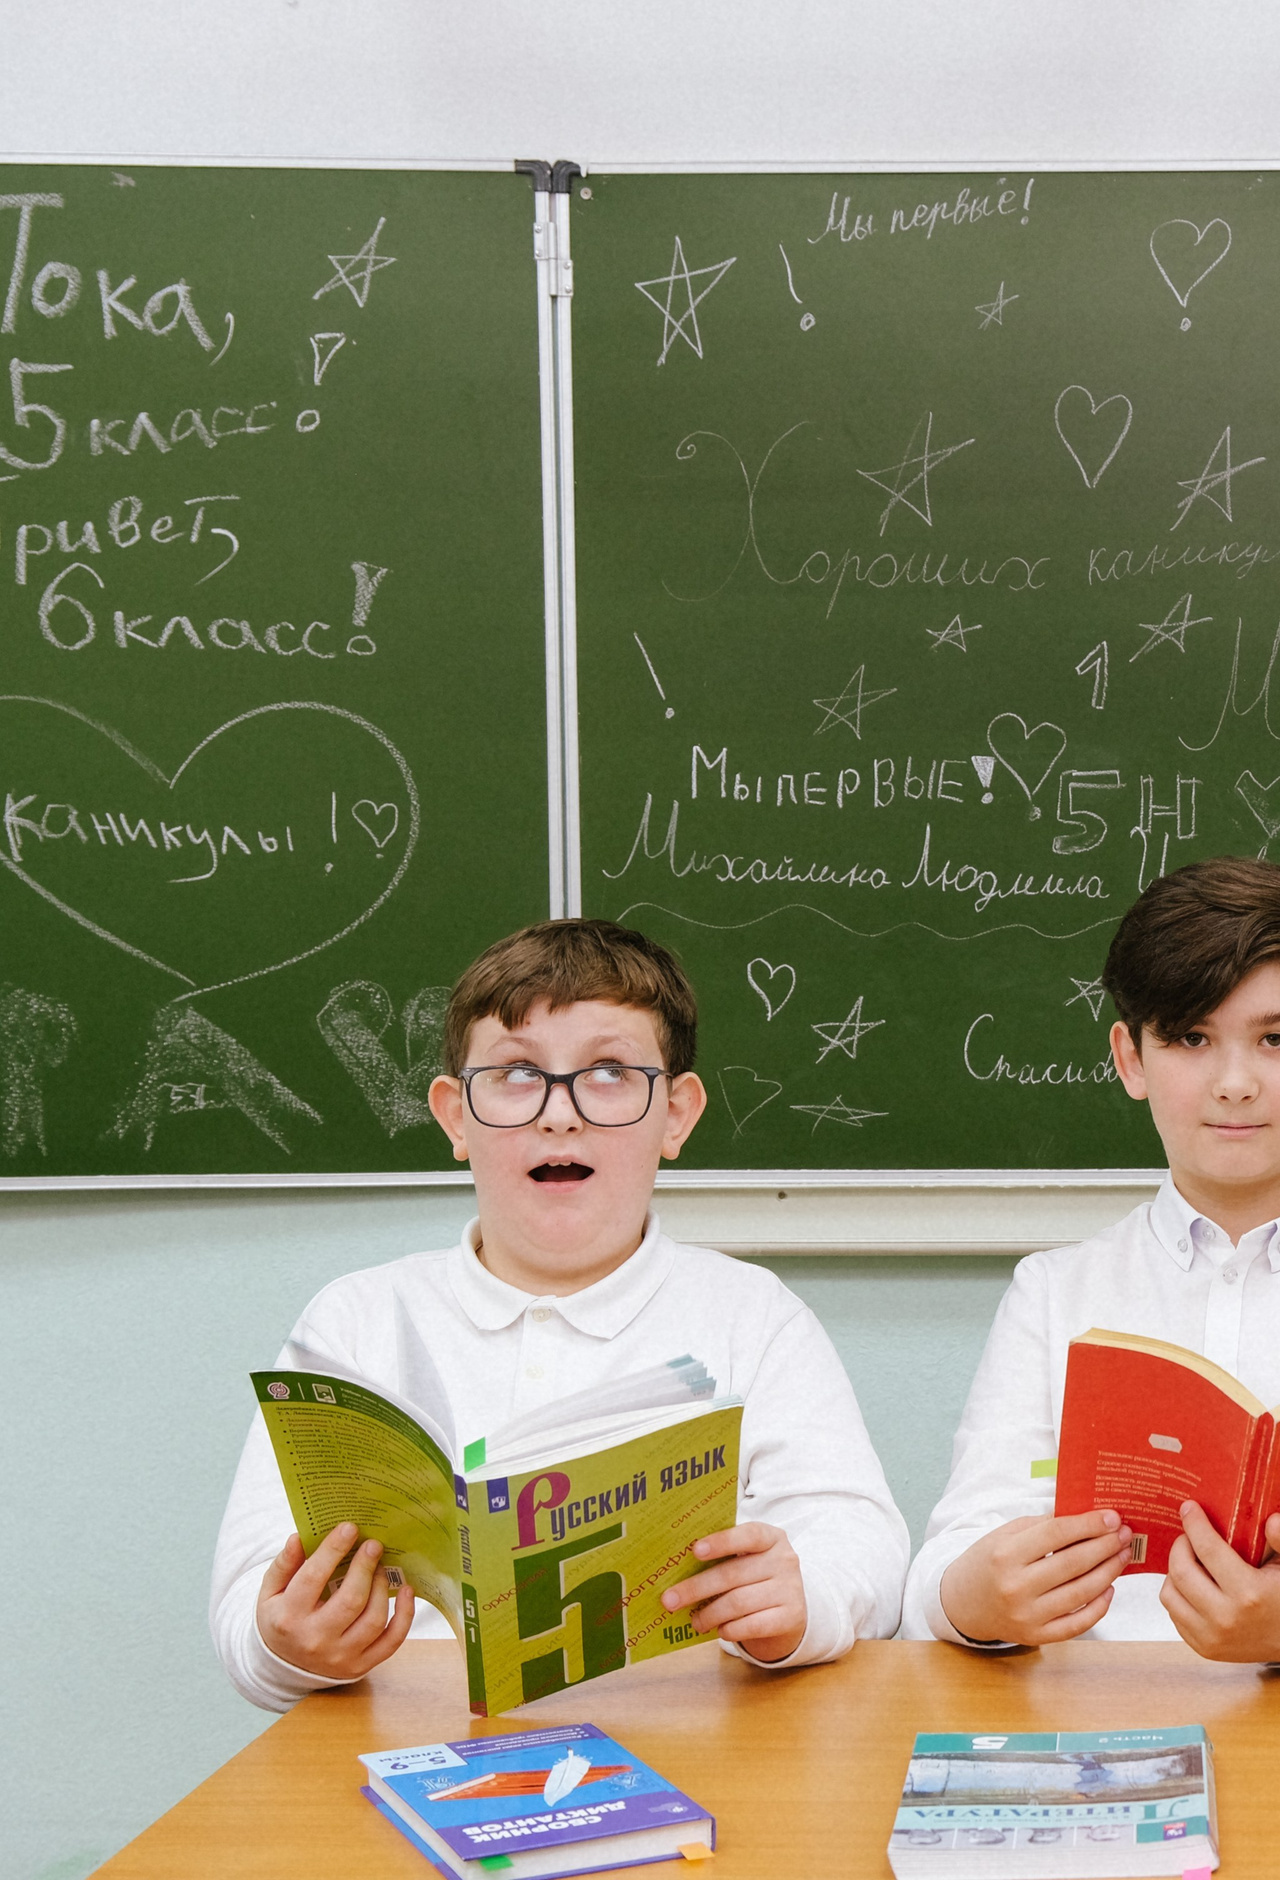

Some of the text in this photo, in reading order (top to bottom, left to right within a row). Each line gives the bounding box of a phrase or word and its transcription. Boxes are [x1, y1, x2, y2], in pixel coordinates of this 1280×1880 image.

[806, 191, 879, 244] Мы
[14, 494, 242, 586] ривет,
[37, 561, 105, 651] 6
[511, 1471, 647, 1551] Русский
[461, 1800, 627, 1836] ДИКТАНТОВ
[469, 1814, 603, 1844] СБОРНИК
